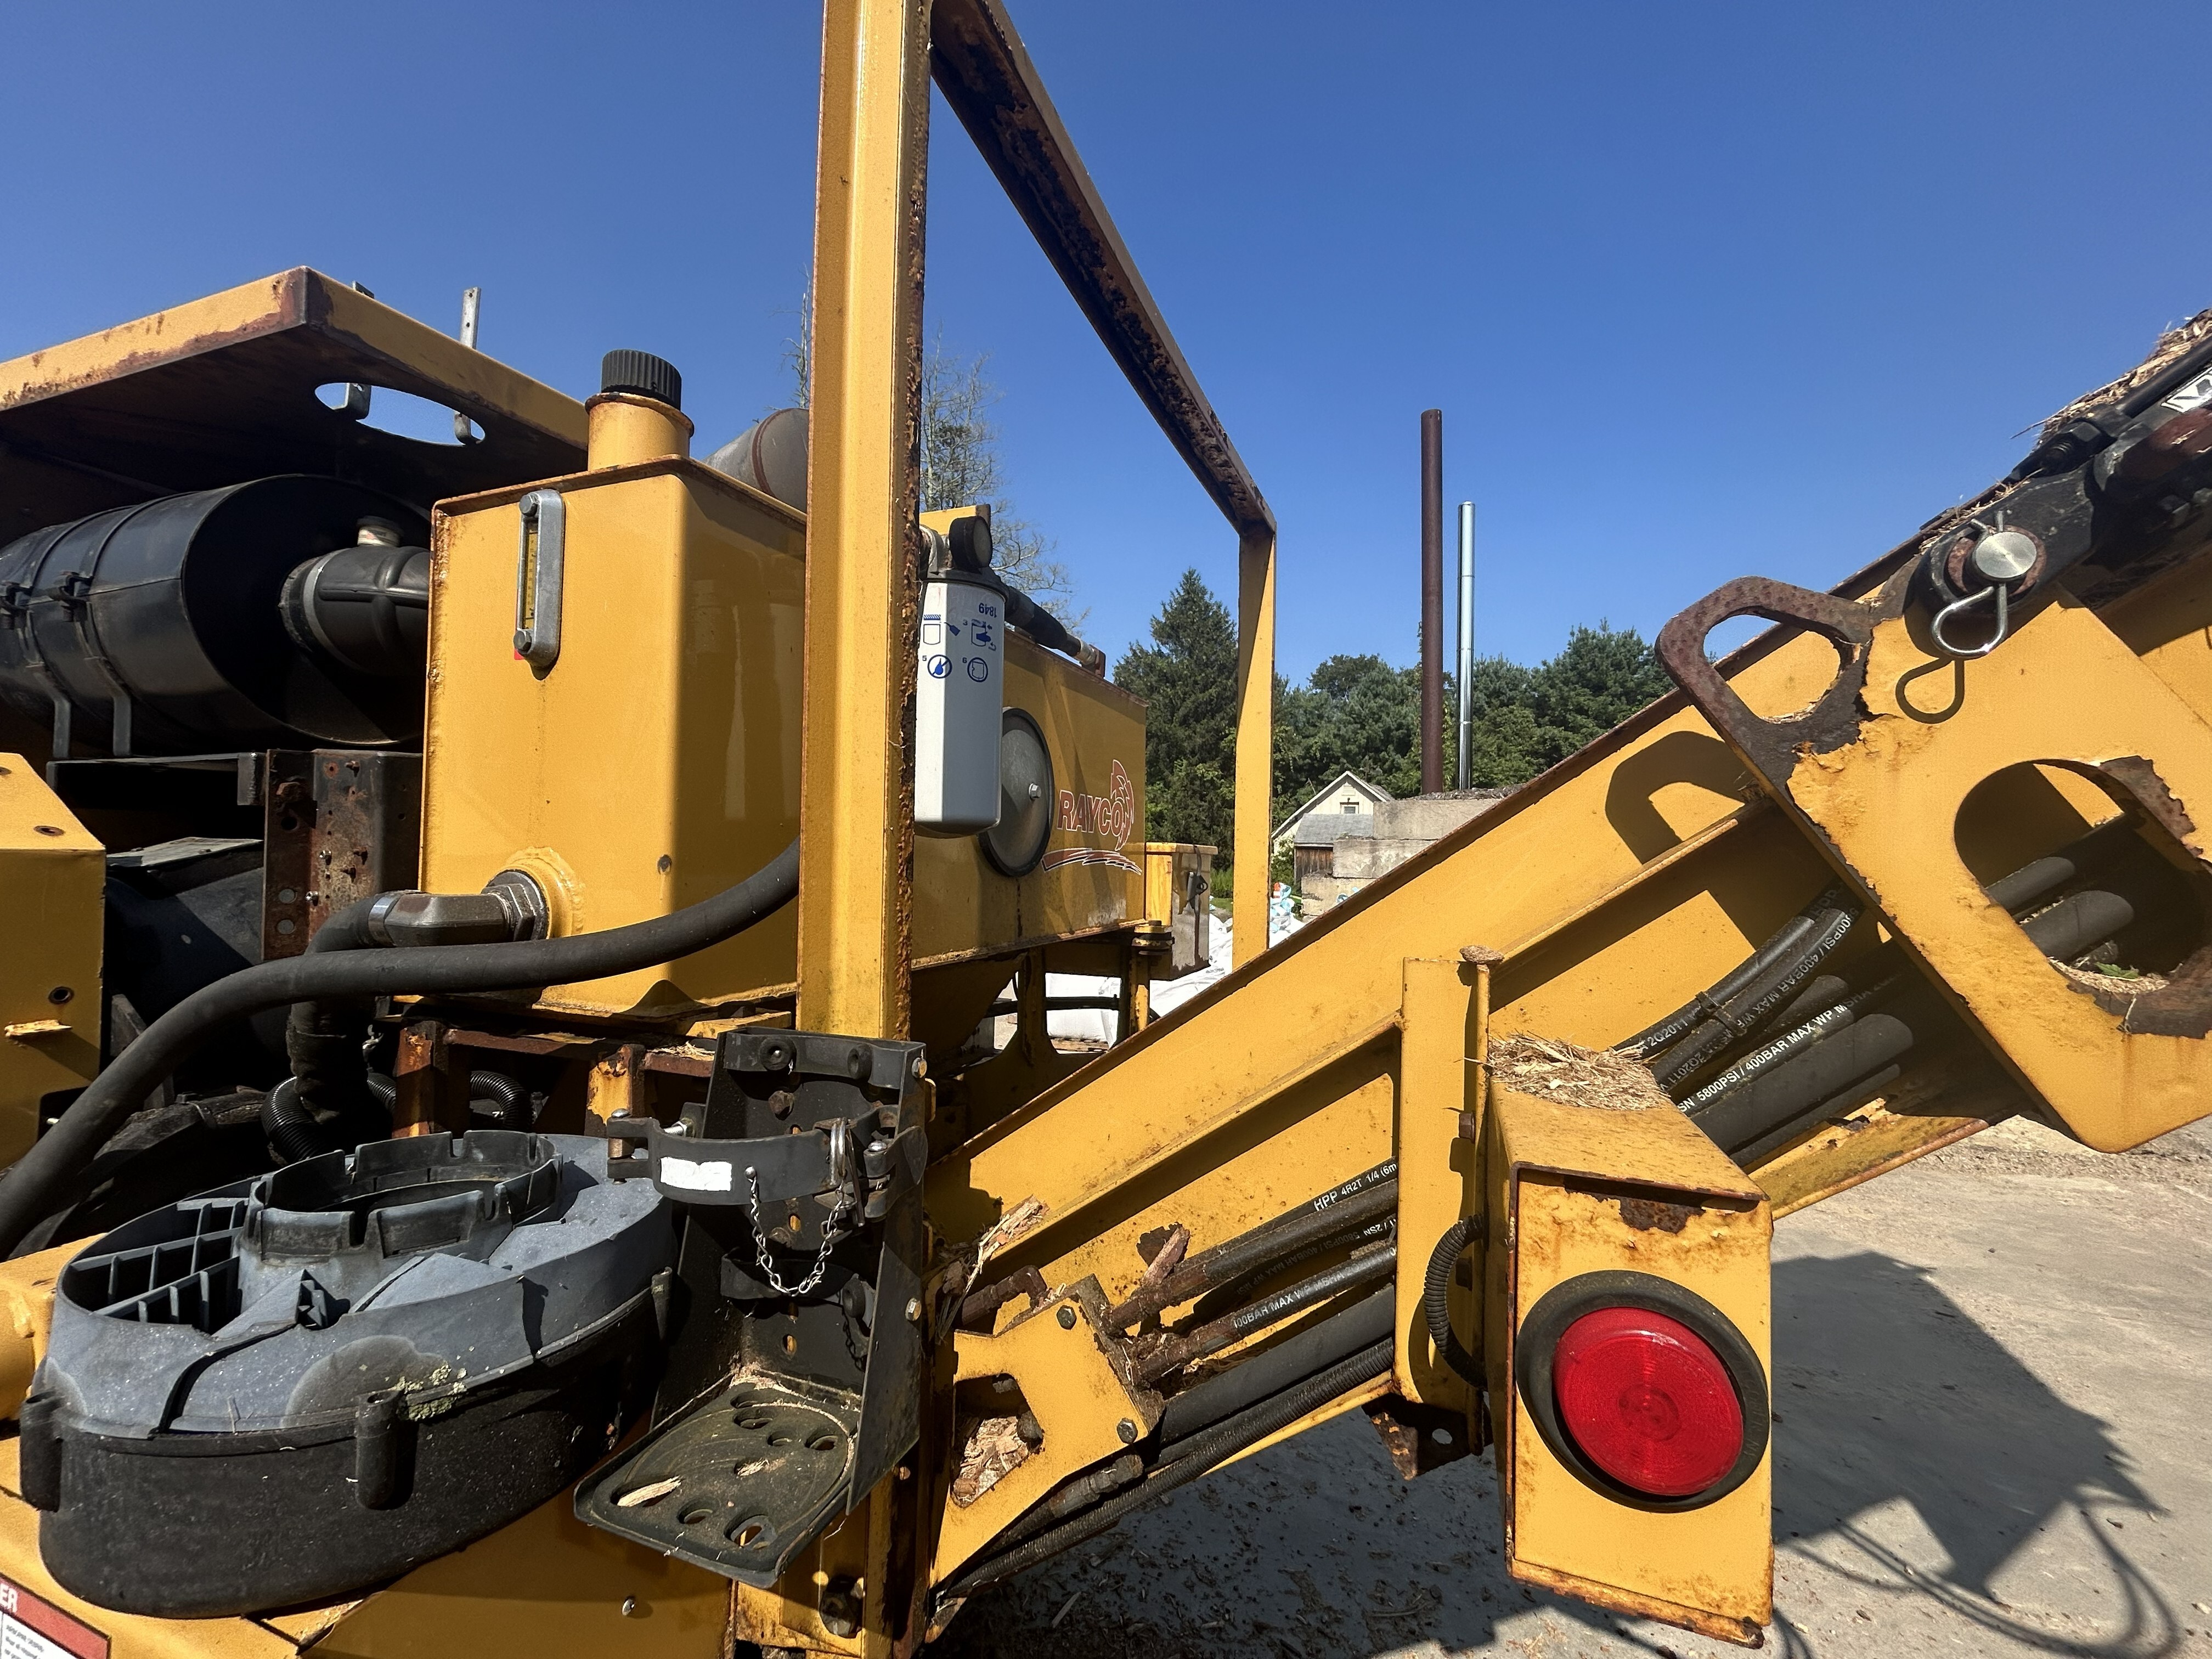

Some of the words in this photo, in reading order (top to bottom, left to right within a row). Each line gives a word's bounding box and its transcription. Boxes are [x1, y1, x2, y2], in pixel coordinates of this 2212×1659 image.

[979, 602, 997, 618] 1849
[1057, 789, 1124, 837] RAYCO
[1778, 953, 1819, 992] 400BAR
[1752, 991, 1780, 1014] MAX
[1647, 1019, 1689, 1047] 2Q2011
[1696, 1070, 1741, 1102] 5800PSI
[1746, 1040, 1790, 1070] 400BAR
[1786, 1022, 1816, 1044] MAX
[1812, 1010, 1833, 1026] WP
[1313, 1190, 1338, 1211] HPP
[1341, 1178, 1362, 1195] 4R2T
[1366, 1170, 1380, 1183] 1/4
[1363, 1223, 1383, 1236] 2SN
[1323, 1232, 1360, 1250] 5800PSI
[1285, 1248, 1317, 1264] 400BAR
[1265, 1260, 1285, 1277] MAX
[1254, 1273, 1267, 1285] WP
[1268, 1293, 1294, 1312] MAX
